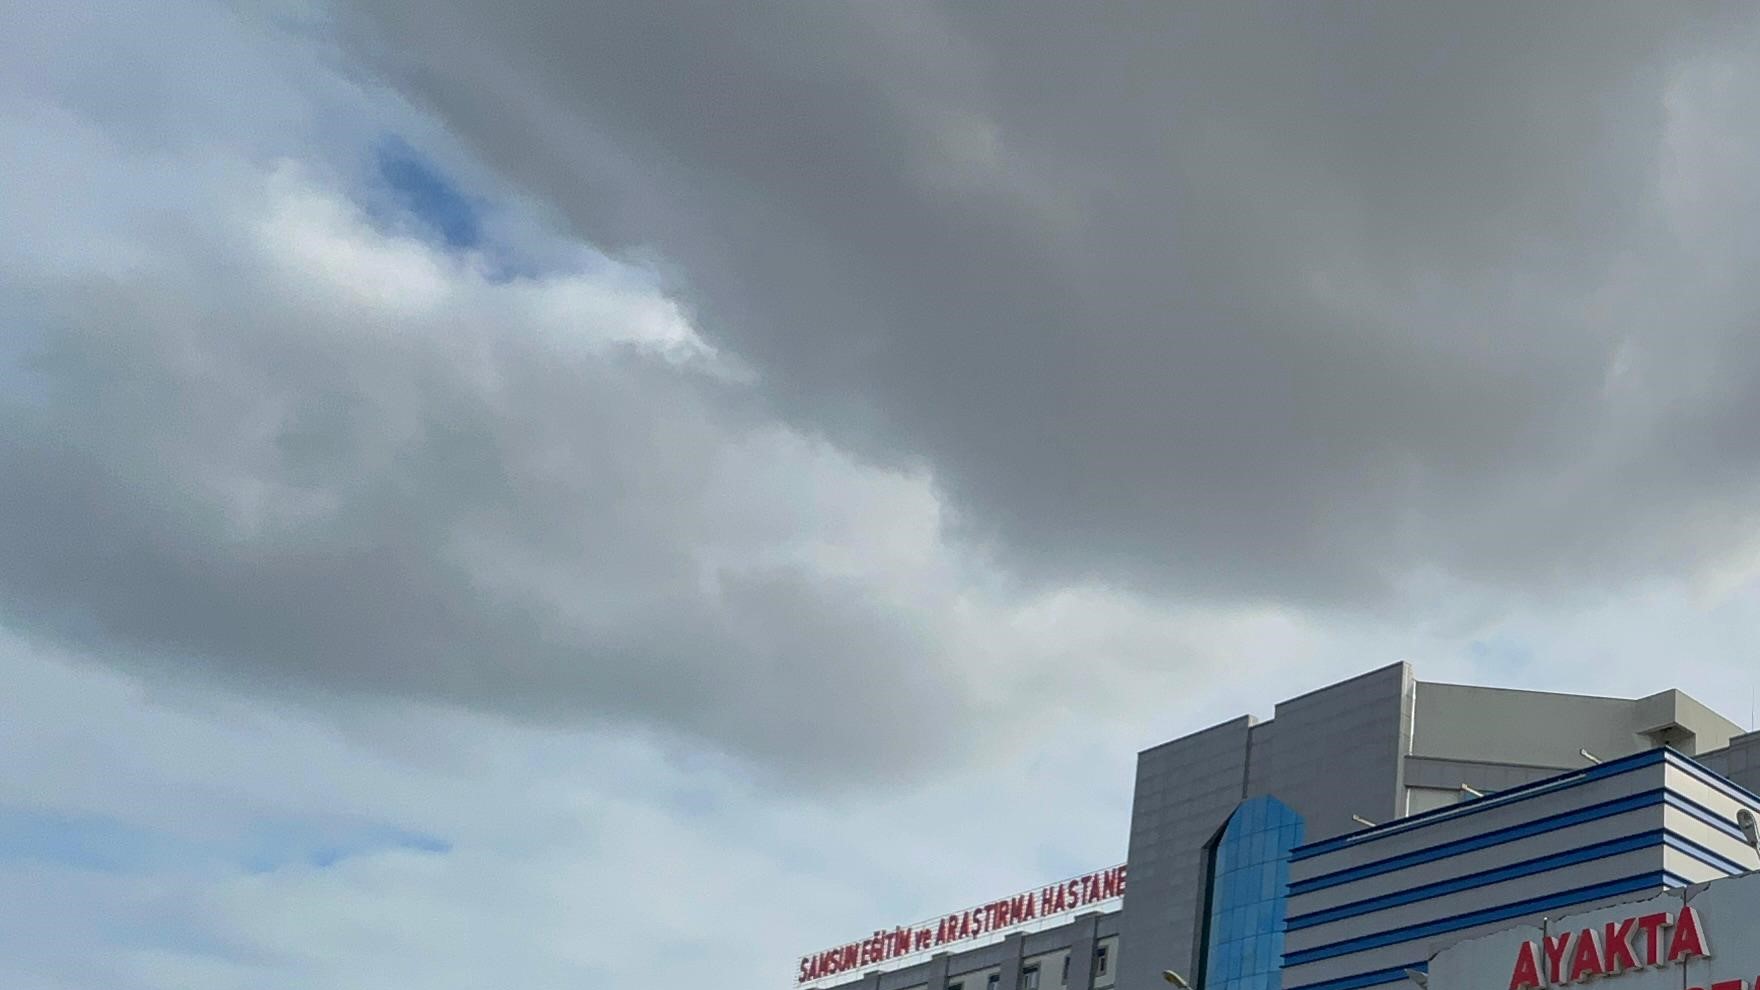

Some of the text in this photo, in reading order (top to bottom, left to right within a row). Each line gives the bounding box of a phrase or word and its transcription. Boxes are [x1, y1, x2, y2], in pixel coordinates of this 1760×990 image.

[799, 943, 860, 983] SAMSUN
[860, 926, 911, 967] EĞİTİM
[936, 892, 1034, 946] ARAŞTIRMA
